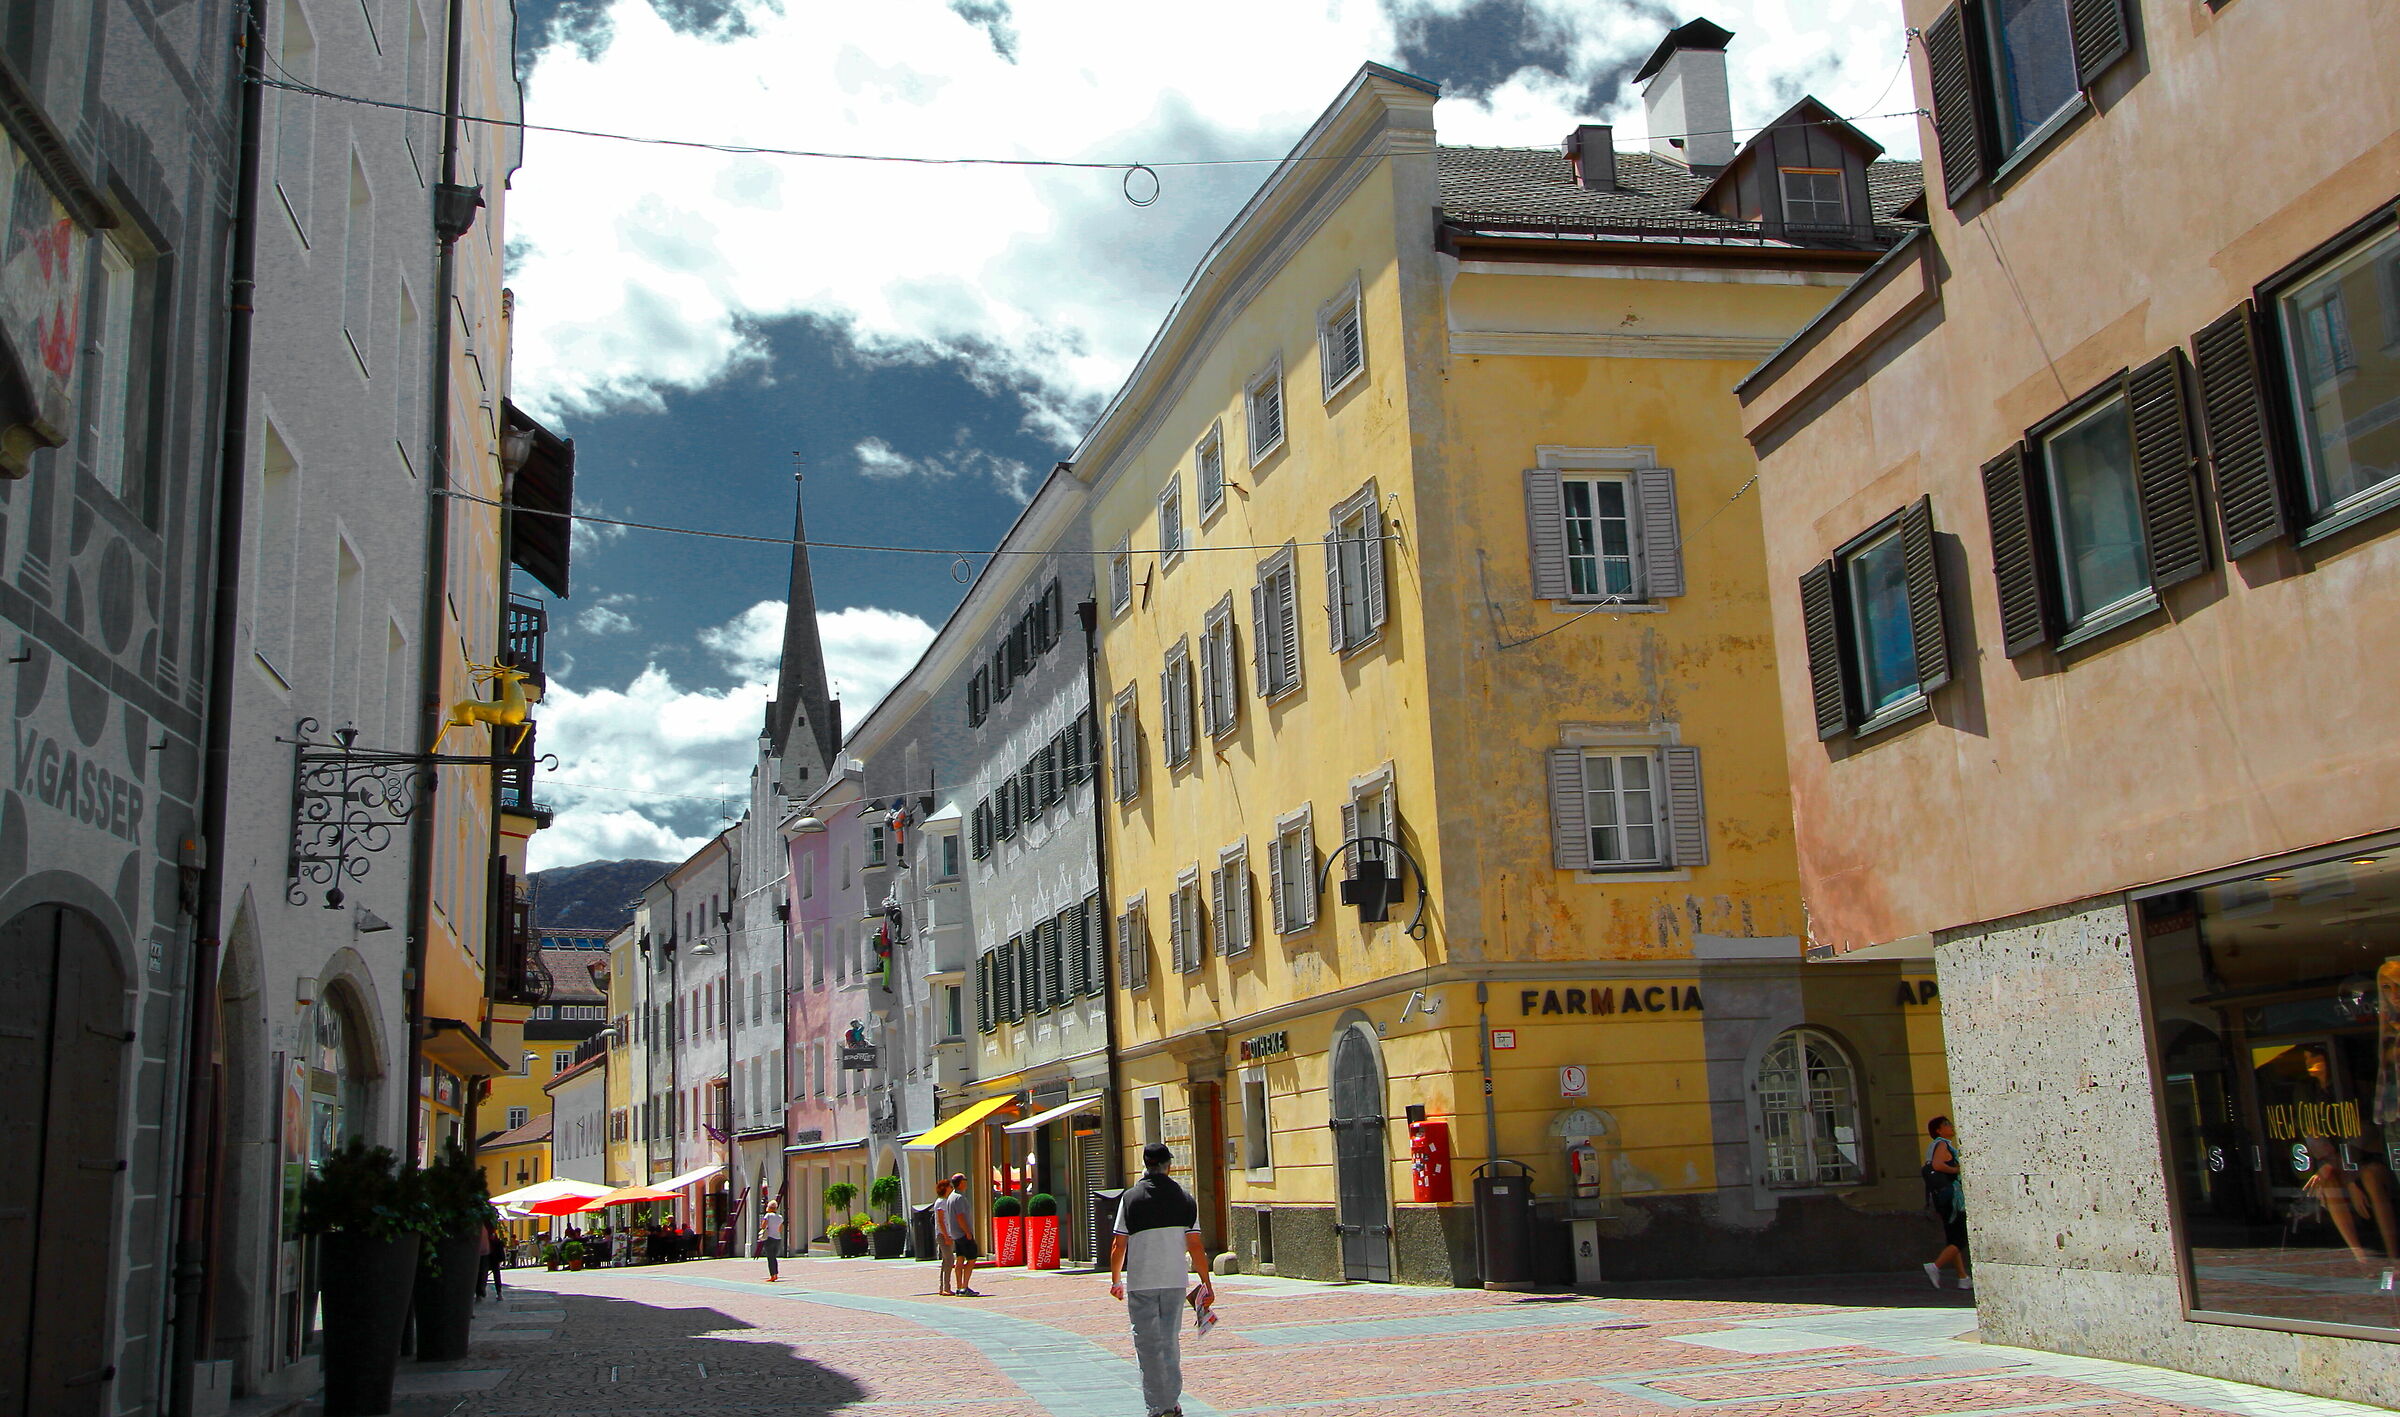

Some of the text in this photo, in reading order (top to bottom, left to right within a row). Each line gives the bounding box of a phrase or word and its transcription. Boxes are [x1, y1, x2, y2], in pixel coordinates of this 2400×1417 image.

[15, 719, 144, 846] V.GASSER
[1521, 985, 1704, 1016] FARMACIA
[2267, 1099, 2362, 1140] NEW COLLECTION
[1001, 1218, 1015, 1265] AUSVERKAUF
[1008, 1226, 1020, 1261] SVENDITA
[1036, 1218, 1053, 1267] AUSVERKAUF
[1044, 1227, 1058, 1263] SVENDITA
